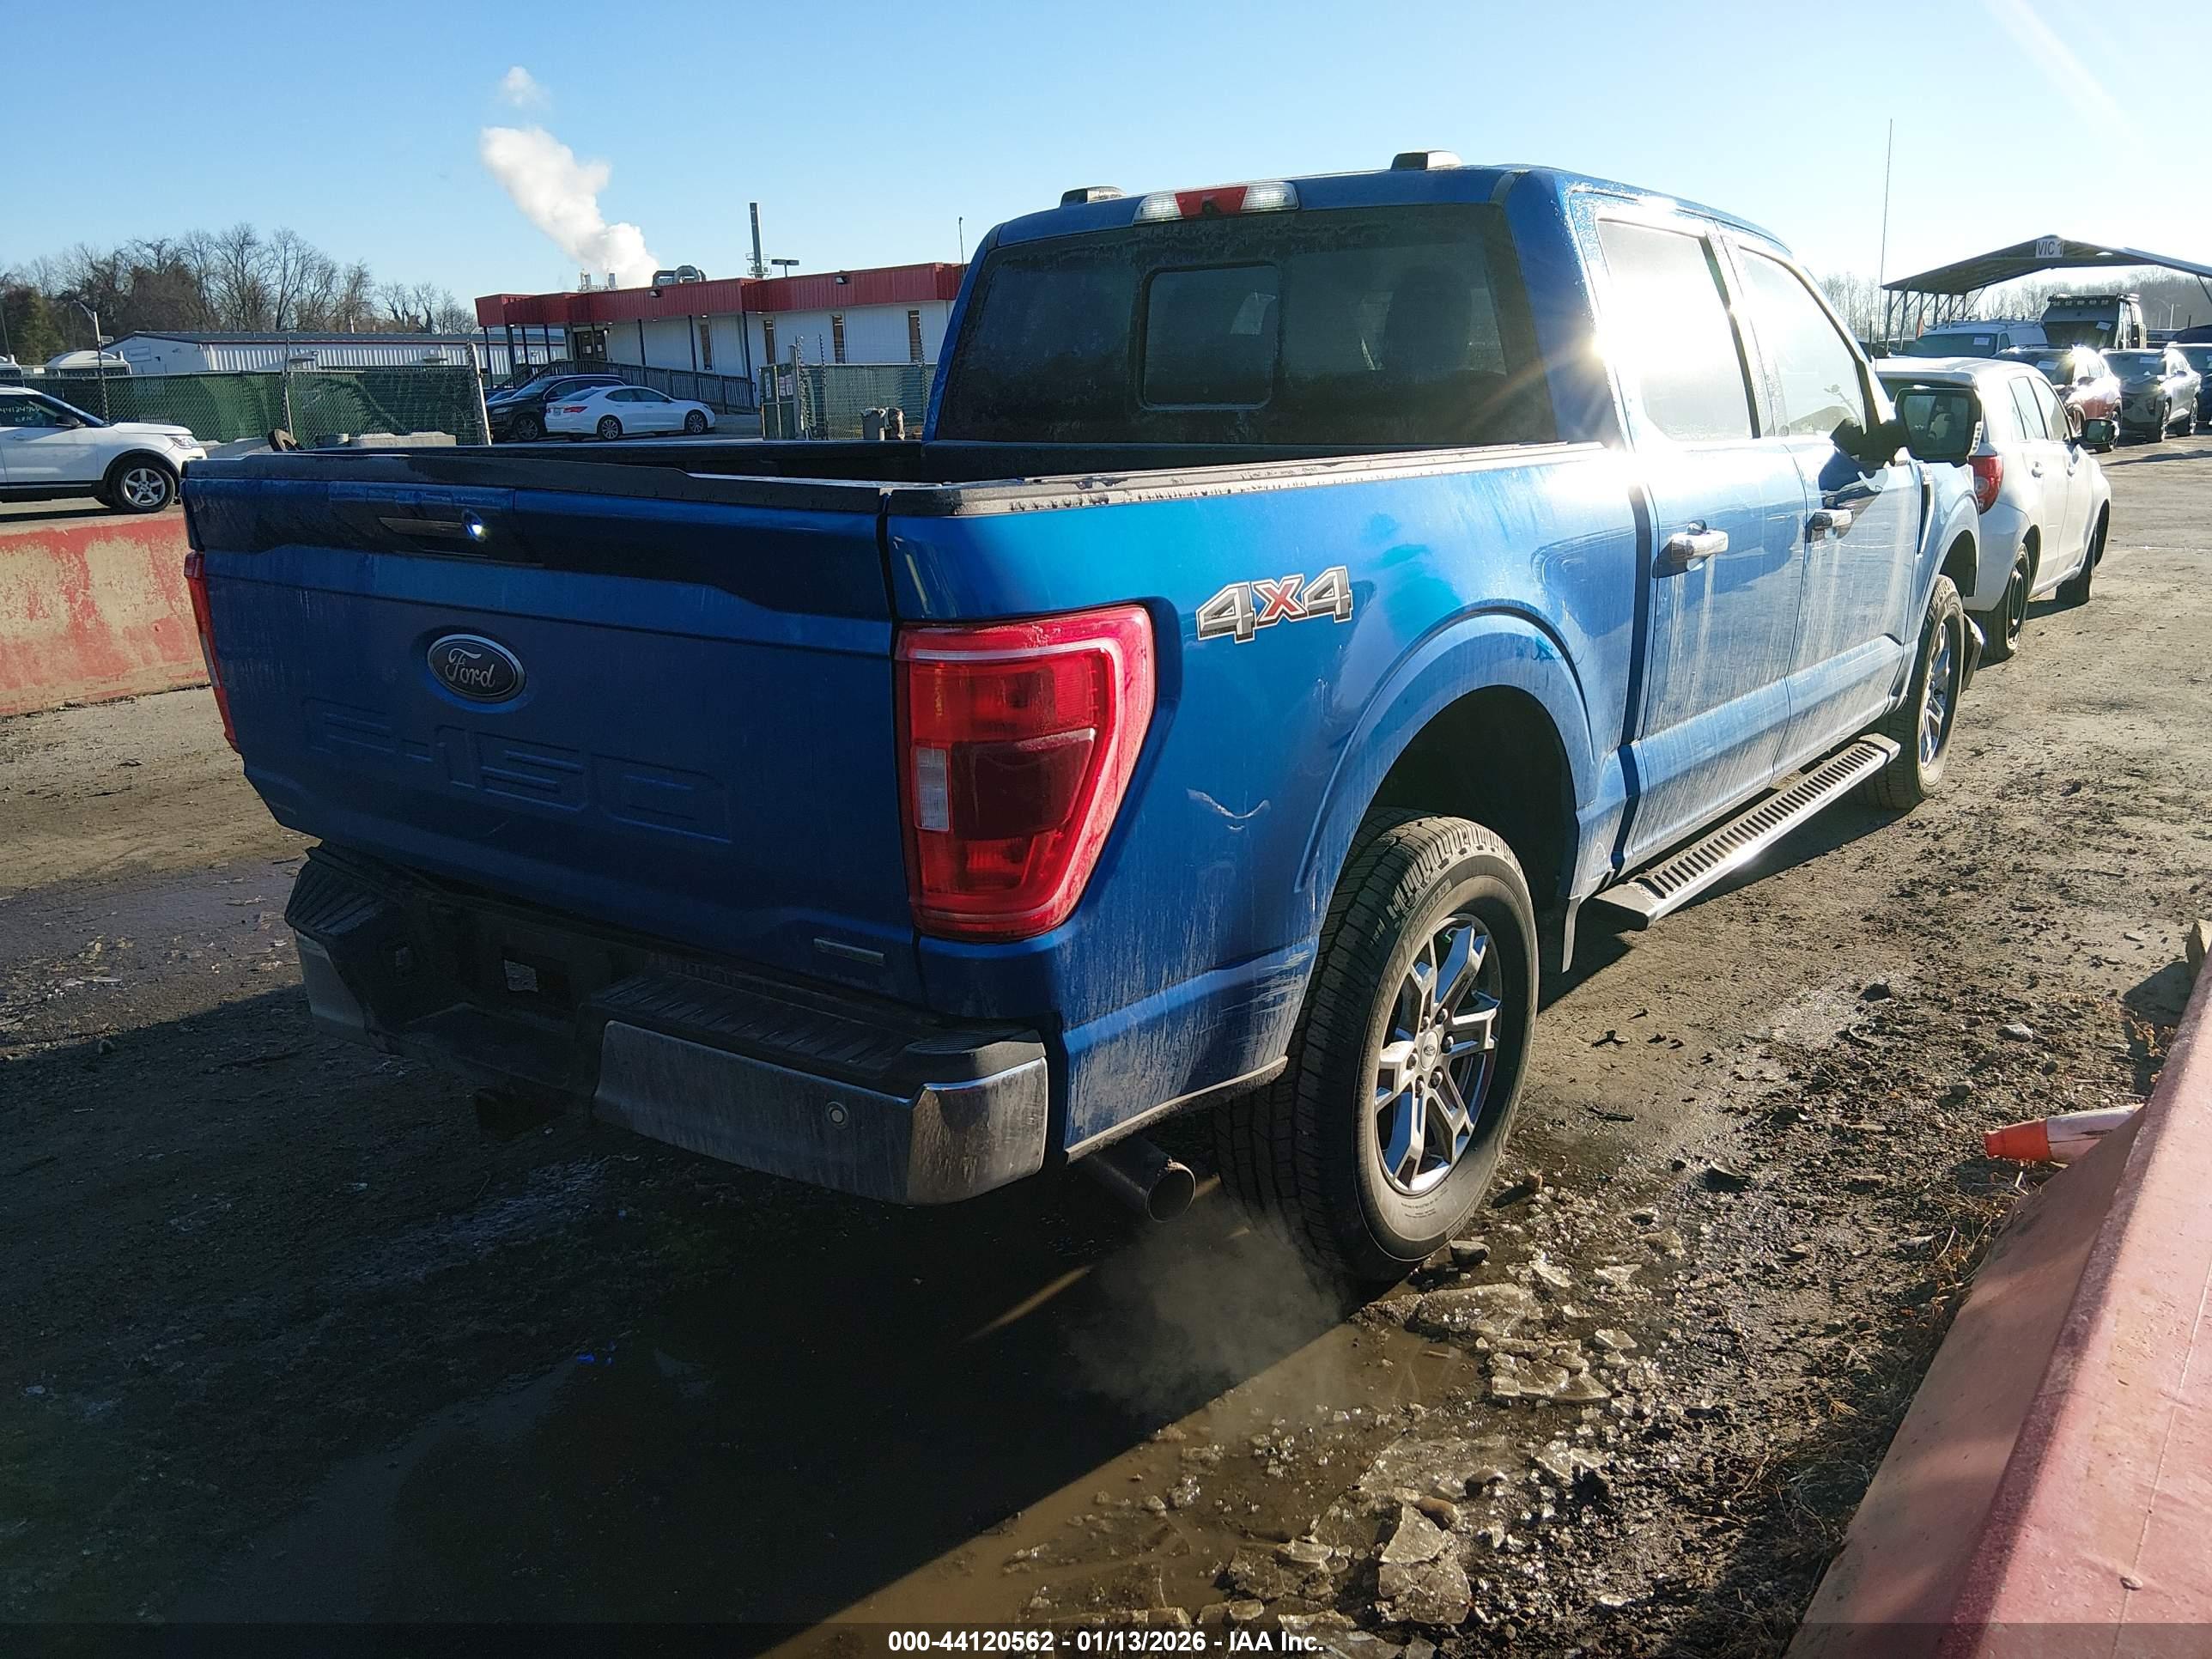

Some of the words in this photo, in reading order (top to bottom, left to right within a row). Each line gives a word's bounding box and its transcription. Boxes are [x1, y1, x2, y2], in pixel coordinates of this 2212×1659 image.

[2038, 240, 2055, 255] VIC
[2057, 240, 2063, 255] 1
[445, 647, 495, 688] Ford
[301, 696, 732, 845] F-150
